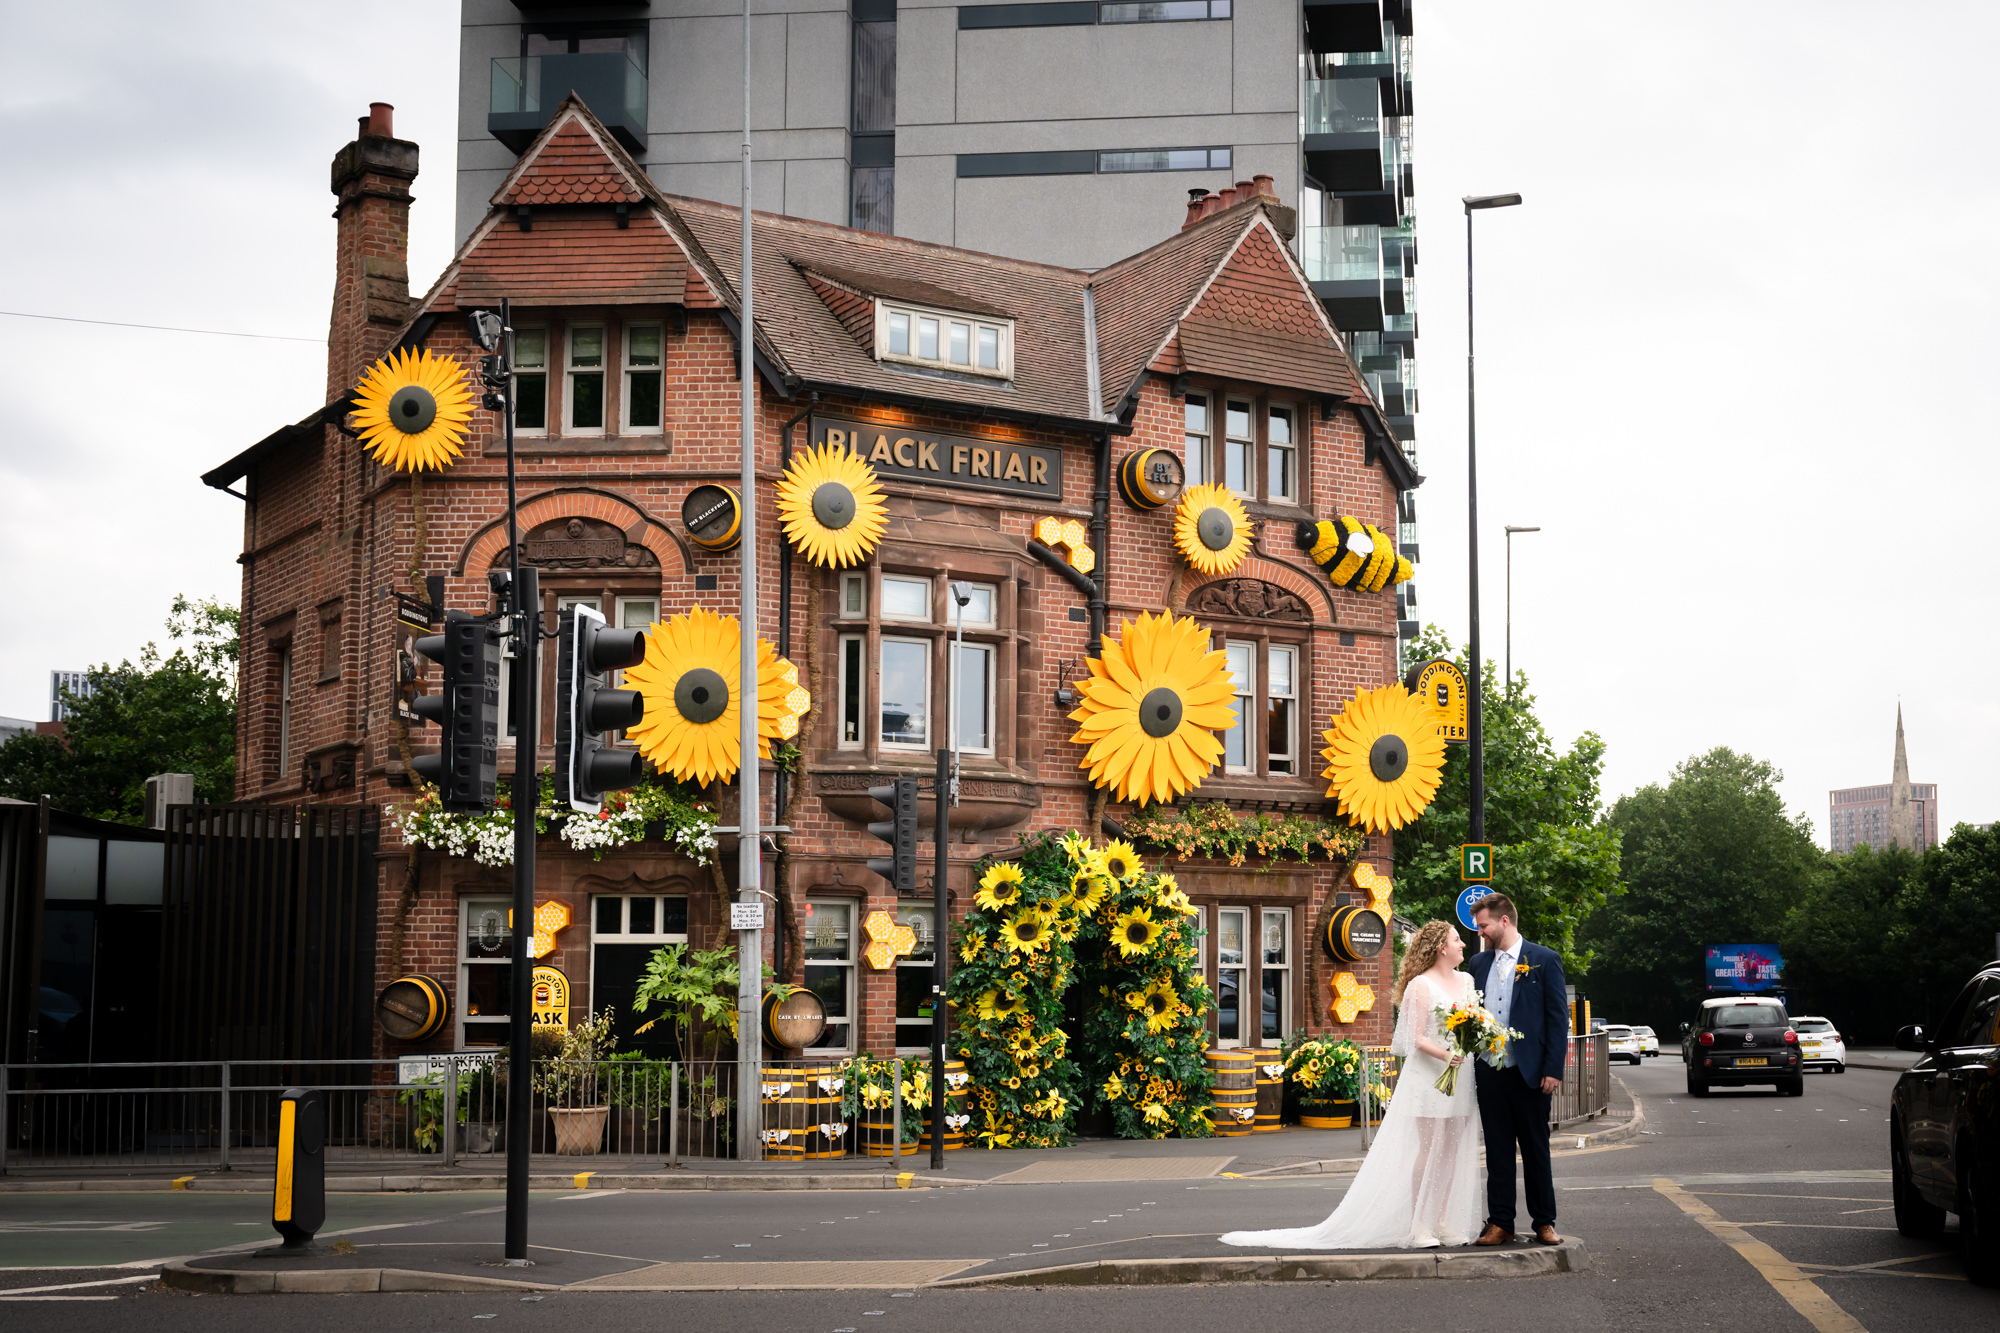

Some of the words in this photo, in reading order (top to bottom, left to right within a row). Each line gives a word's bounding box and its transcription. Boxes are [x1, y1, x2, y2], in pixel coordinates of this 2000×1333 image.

[827, 428, 940, 471] BLACK
[951, 445, 1048, 485] FRIAR
[1154, 463, 1172, 472] BY
[1152, 473, 1174, 484] ECK
[688, 518, 698, 526] THE
[402, 608, 428, 624] BODDINGTONS
[1420, 664, 1465, 700] BODDINGTONS
[400, 710, 410, 718] BLACK
[410, 712, 419, 720] FRIAR
[1470, 852, 1486, 874] R
[819, 916, 833, 928] THE
[816, 928, 836, 937] BLACK
[816, 938, 836, 948] FRIAR
[1715, 969, 1746, 977] GREATEST
[1758, 965, 1776, 974] TASTE
[532, 1012, 562, 1025] ASK
[431, 1056, 494, 1068] BLACKFRIA
